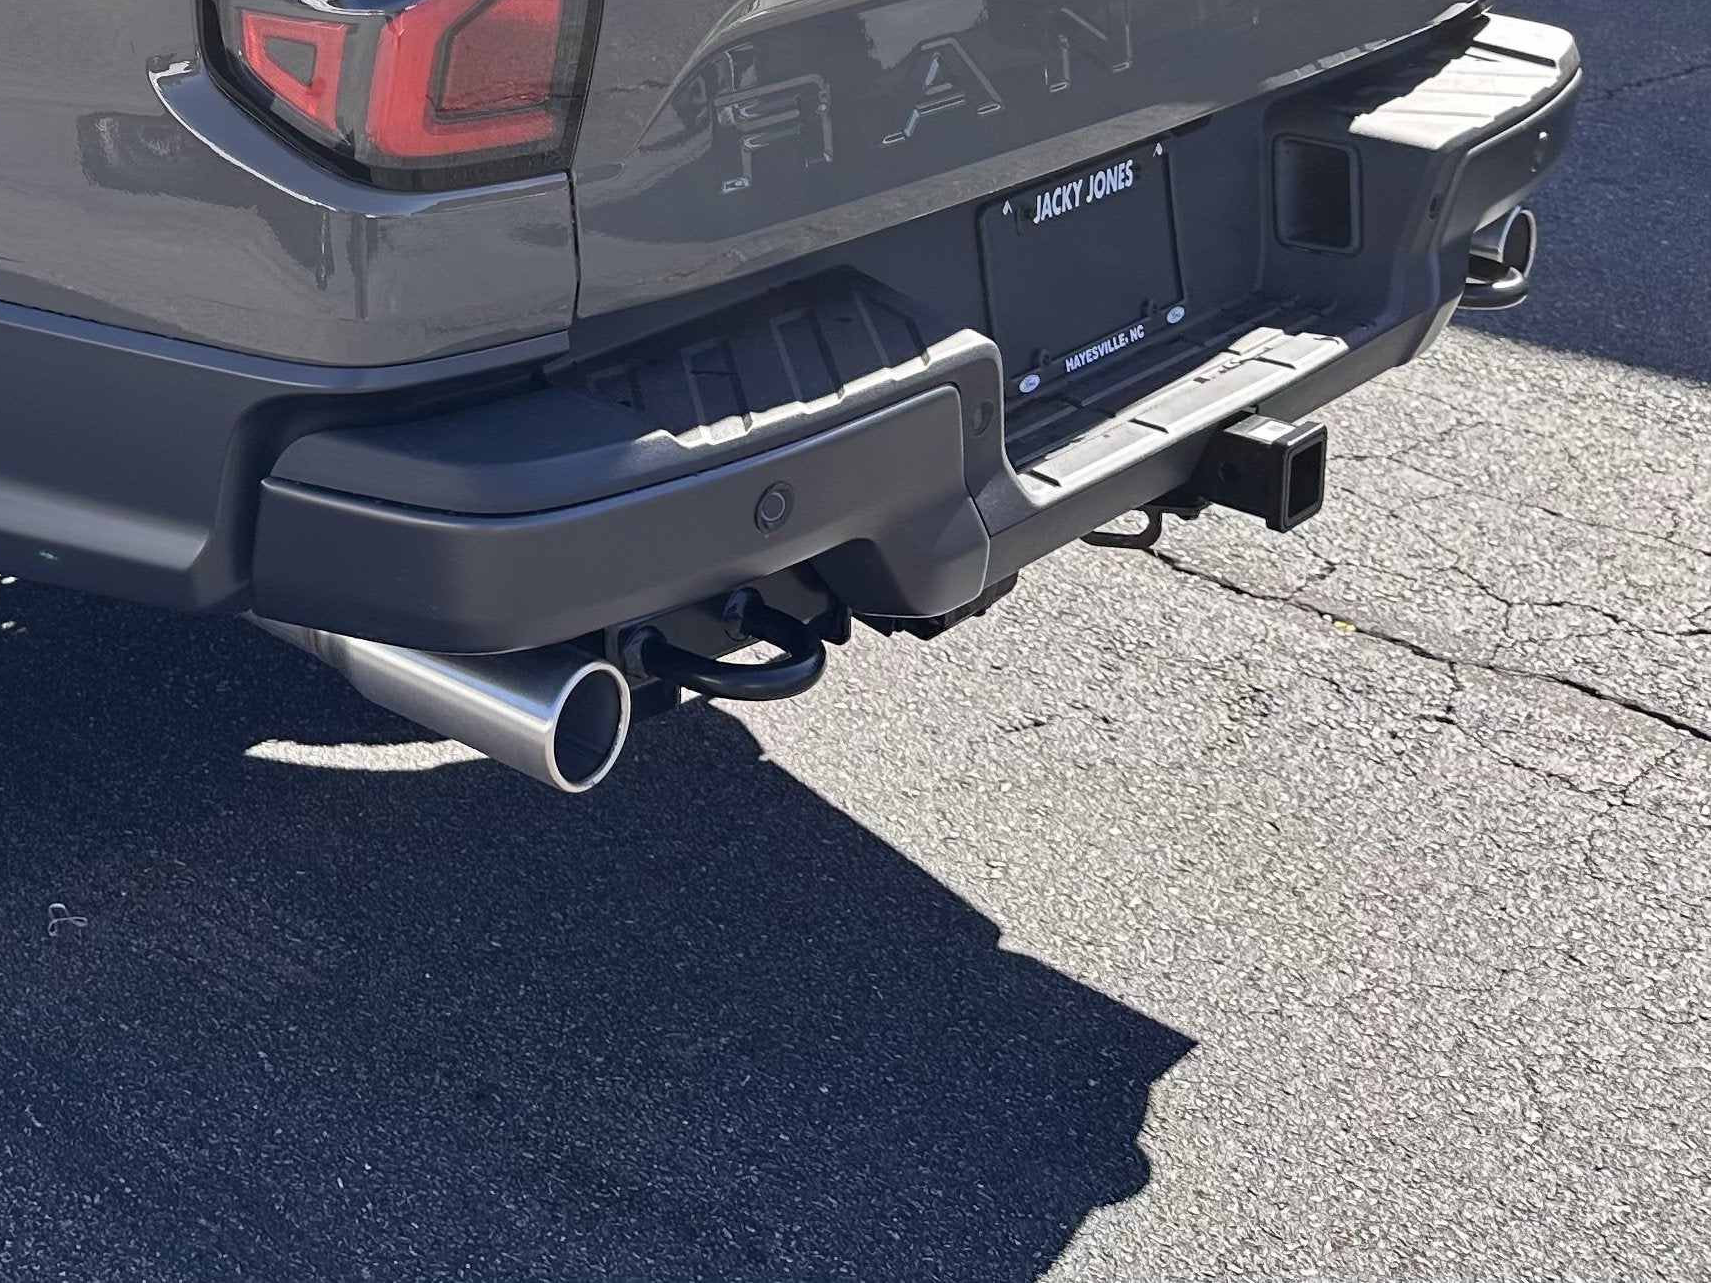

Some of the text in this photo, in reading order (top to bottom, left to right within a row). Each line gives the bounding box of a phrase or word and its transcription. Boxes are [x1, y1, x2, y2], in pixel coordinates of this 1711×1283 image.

[1033, 159, 1133, 224] JACKY JONES
[1065, 324, 1145, 373] HAYESVILLE, NC
